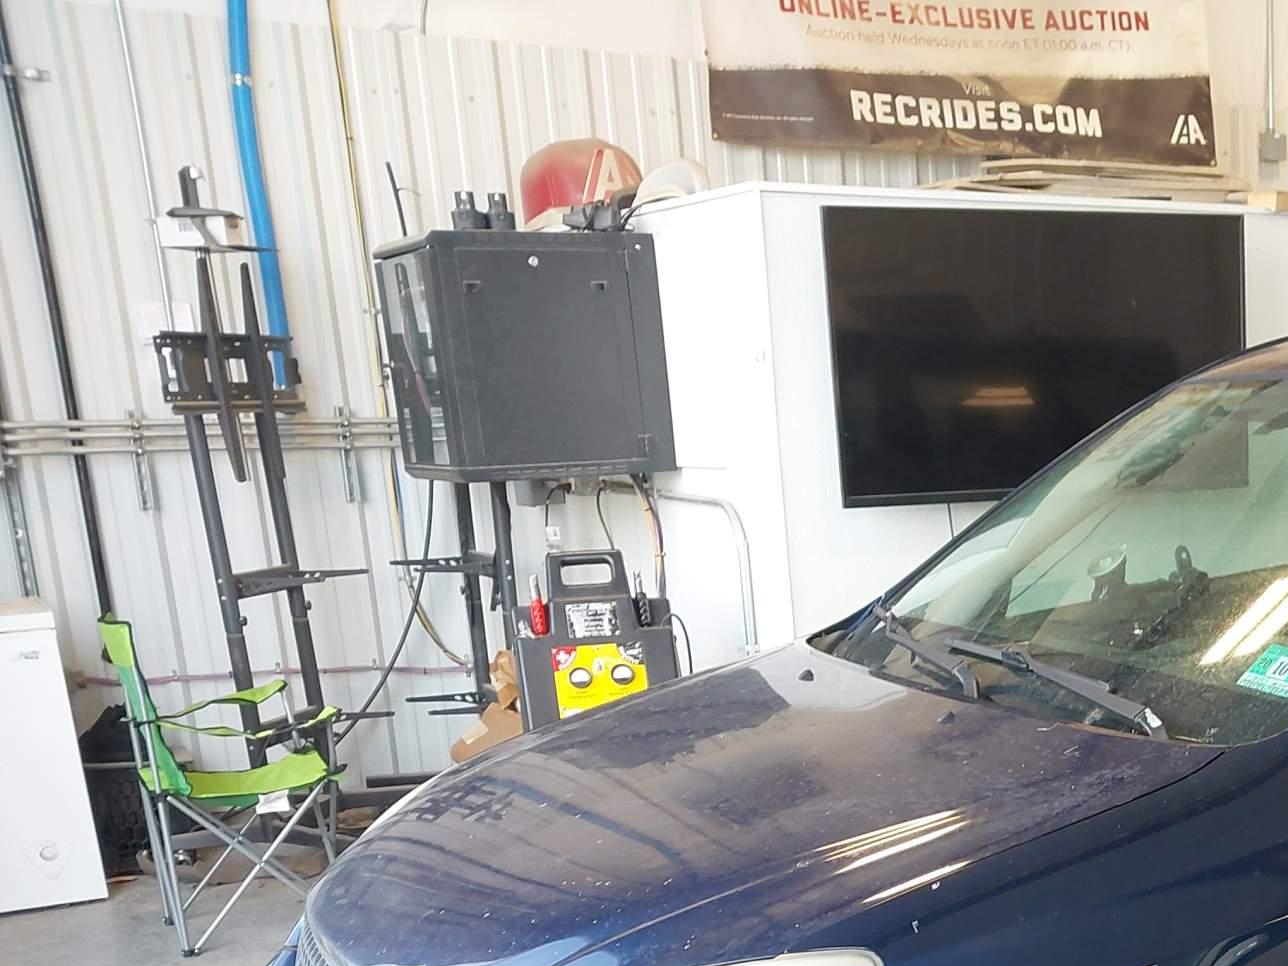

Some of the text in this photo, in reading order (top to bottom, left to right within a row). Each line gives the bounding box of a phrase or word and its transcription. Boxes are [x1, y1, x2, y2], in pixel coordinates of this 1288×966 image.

[779, 0, 1150, 32] ONLINE-EXCLUSIVE AUCTION
[805, 24, 855, 42] Auction
[858, 31, 884, 45] held
[890, 33, 969, 50] Wednesdays
[1024, 38, 1041, 51] ET
[962, 82, 991, 97] Visit
[849, 89, 1103, 138] RECRIDES.COM
